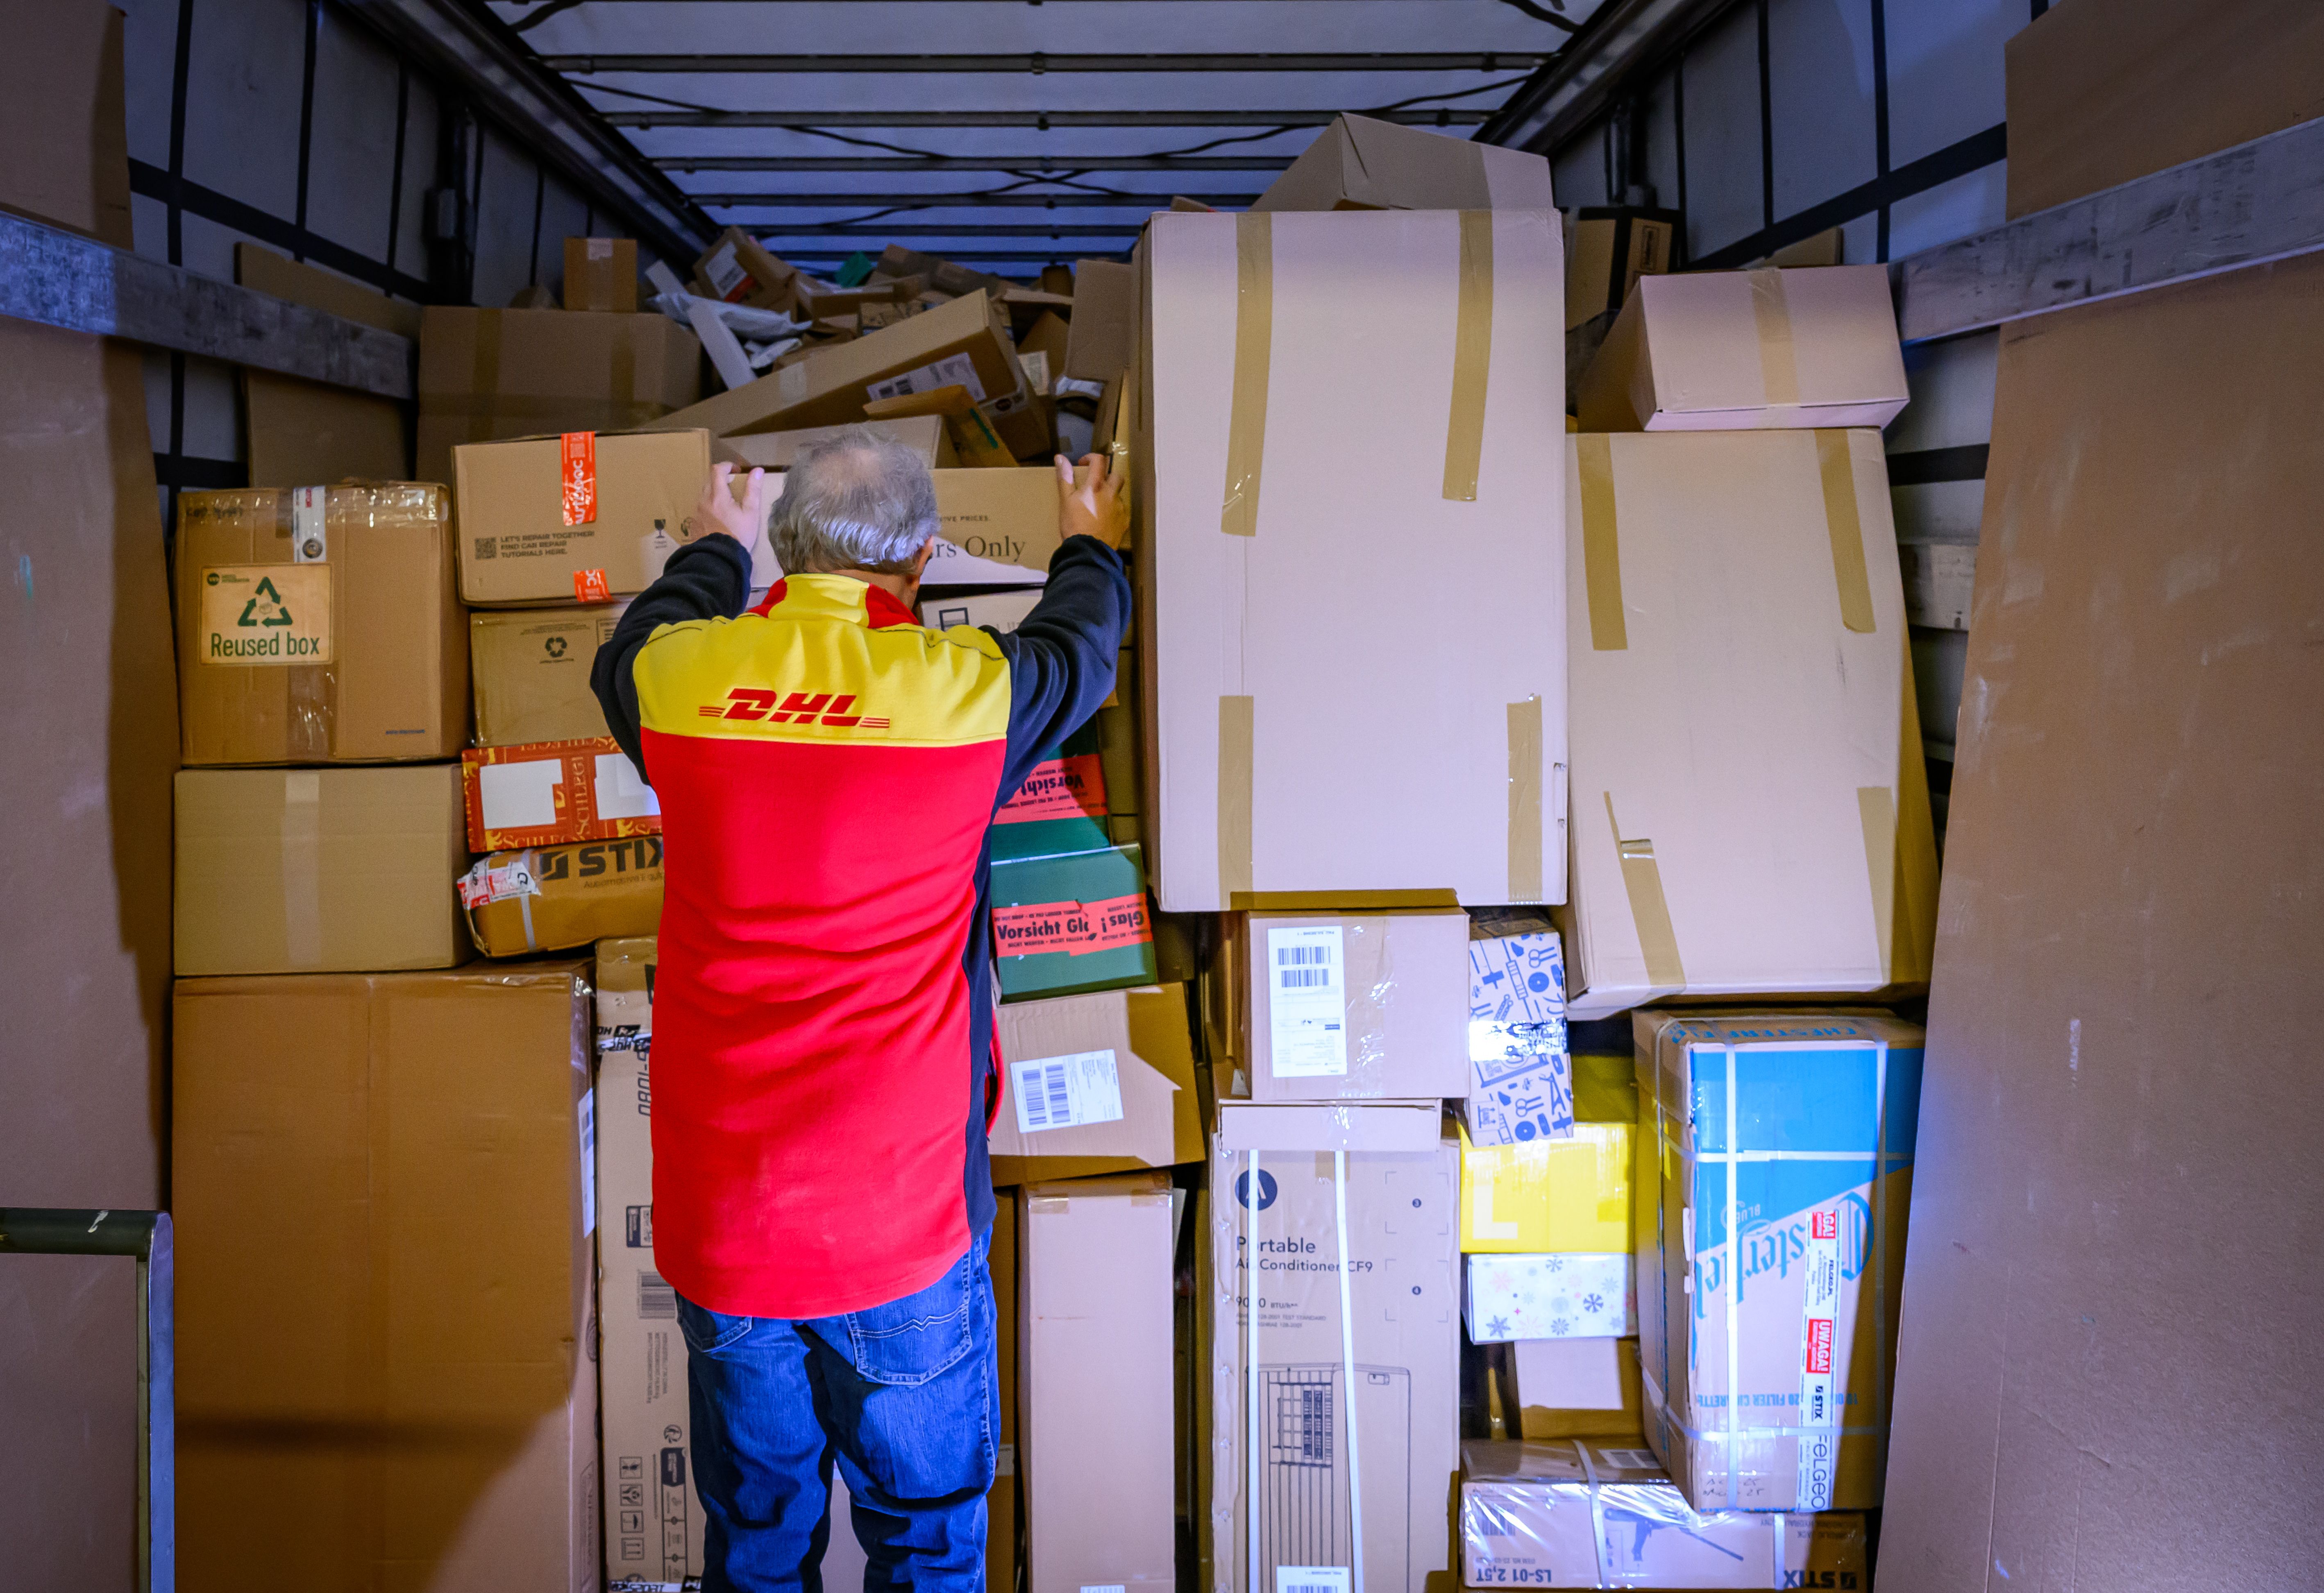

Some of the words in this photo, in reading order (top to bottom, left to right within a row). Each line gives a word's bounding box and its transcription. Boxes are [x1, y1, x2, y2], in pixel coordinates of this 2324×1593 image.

[932, 543, 957, 558] rs
[965, 535, 1026, 562] Only
[211, 632, 279, 657] Reused
[286, 631, 320, 655] box
[724, 688, 861, 727] DHL
[997, 919, 1060, 940] Vorsicht
[1236, 1236, 1316, 1253] Prtable
[1348, 1260, 1373, 1273] CF9
[1236, 1296, 1266, 1308] 900
[1816, 1321, 1831, 1371] UWAGA!
[1752, 1394, 1786, 1407] FILTER
[1814, 1395, 1823, 1420] STIX
[1476, 1566, 1506, 1582] 2,5T
[1513, 1569, 1551, 1583] LS-01
[1784, 1570, 1836, 1588] STIX
